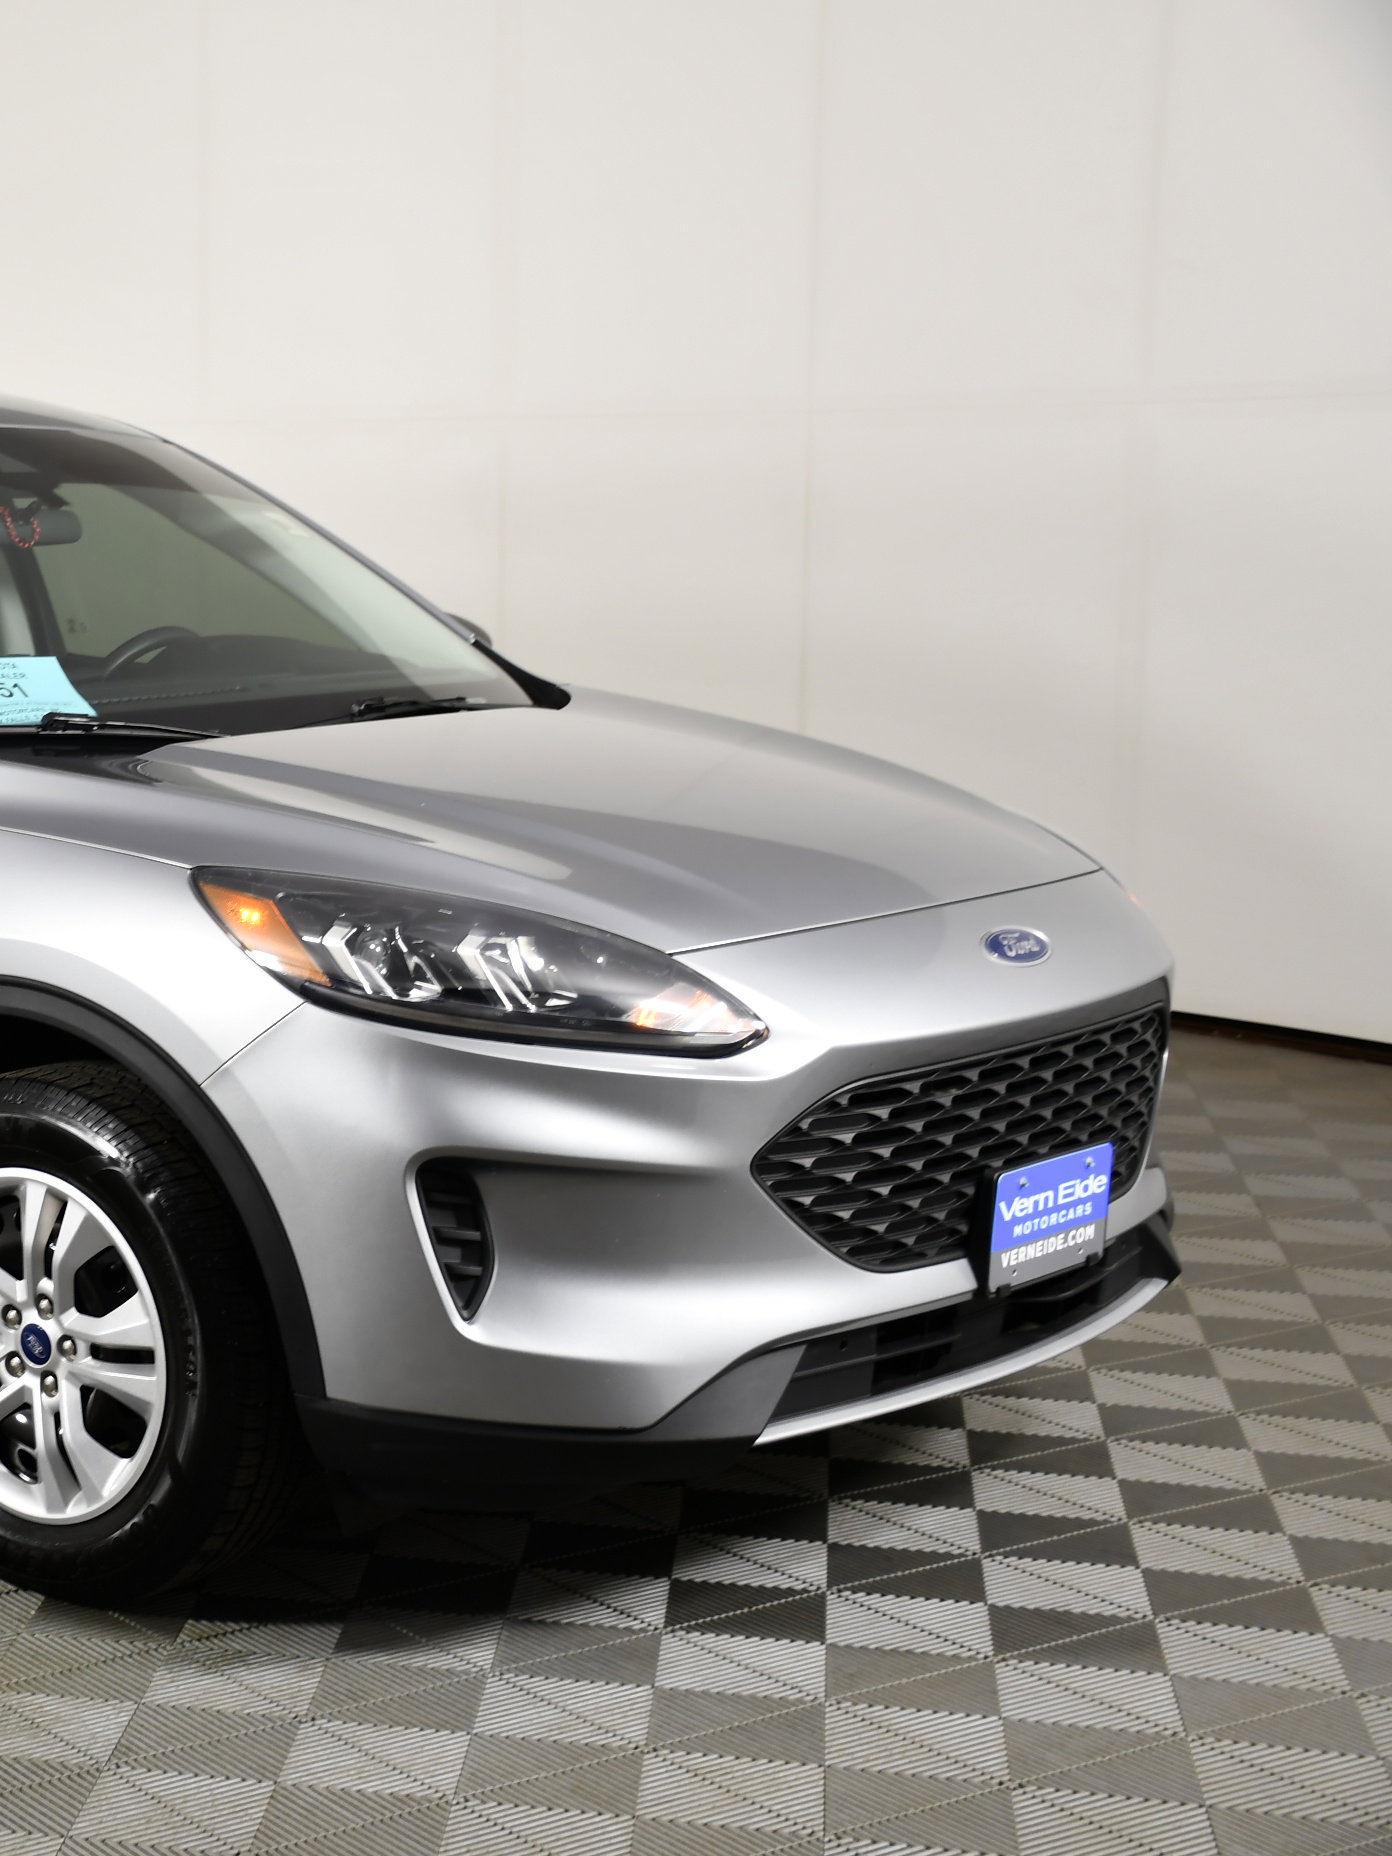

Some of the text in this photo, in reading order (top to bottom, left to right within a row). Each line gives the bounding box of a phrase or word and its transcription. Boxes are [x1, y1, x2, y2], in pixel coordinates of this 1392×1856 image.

[999, 1174, 1107, 1222] Vern Eide
[1013, 1202, 1093, 1238] MOTORCARS
[1001, 1224, 1096, 1268] VERNEIDE.COM
